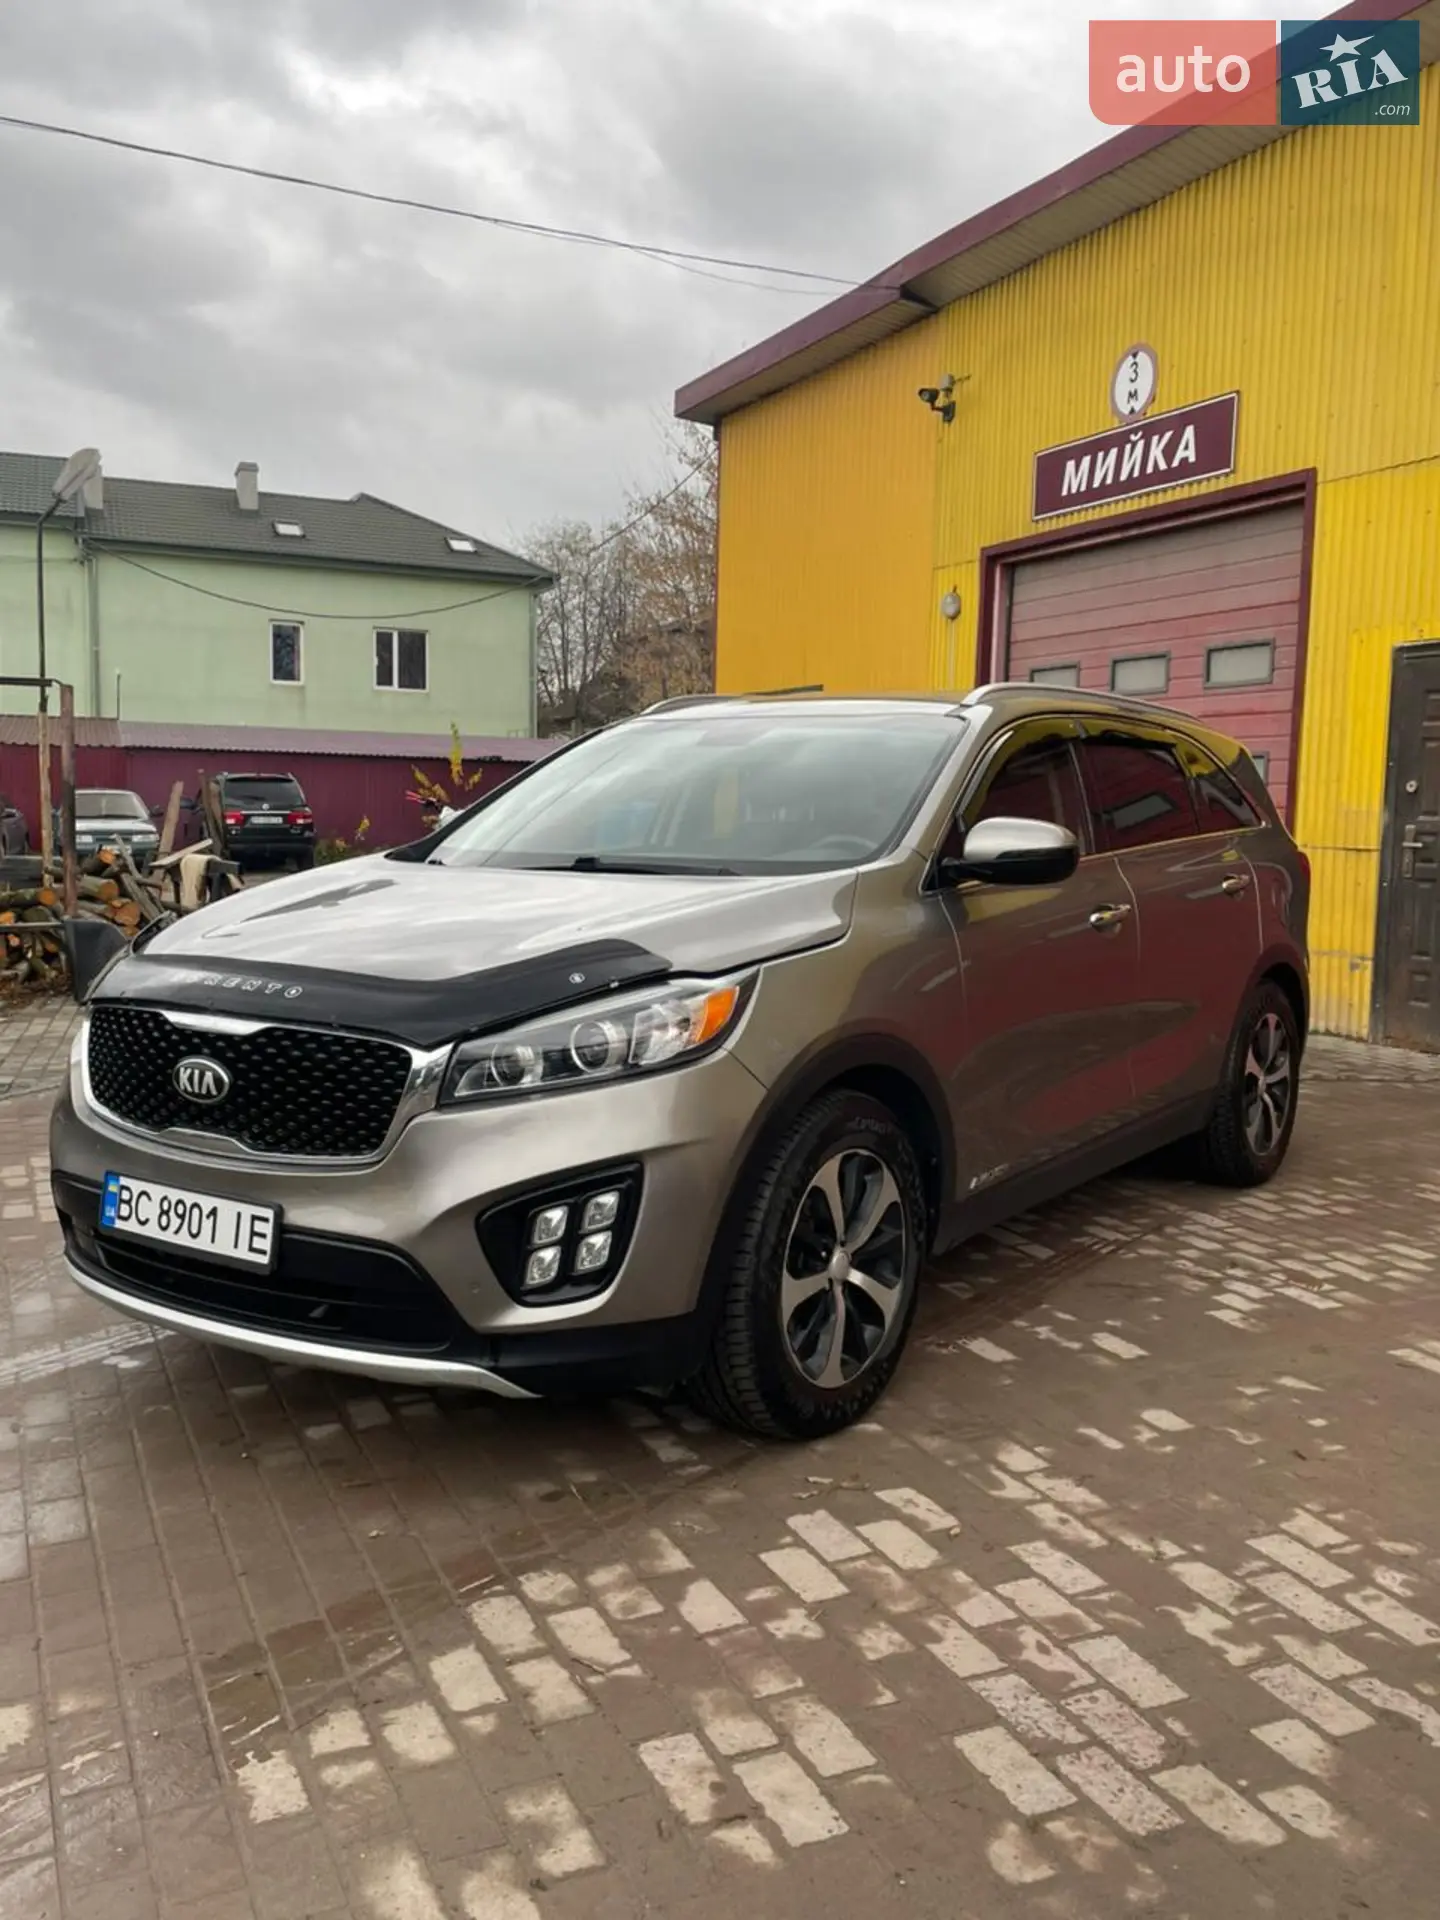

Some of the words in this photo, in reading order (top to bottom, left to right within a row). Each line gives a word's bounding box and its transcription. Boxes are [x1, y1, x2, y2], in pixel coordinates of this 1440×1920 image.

[1129, 361, 1139, 383] 3
[1061, 424, 1197, 496] МИЙКА
[179, 1067, 217, 1095] KIA
[117, 1184, 152, 1226] BC
[157, 1195, 218, 1245] 8901
[233, 1211, 270, 1256] IE
